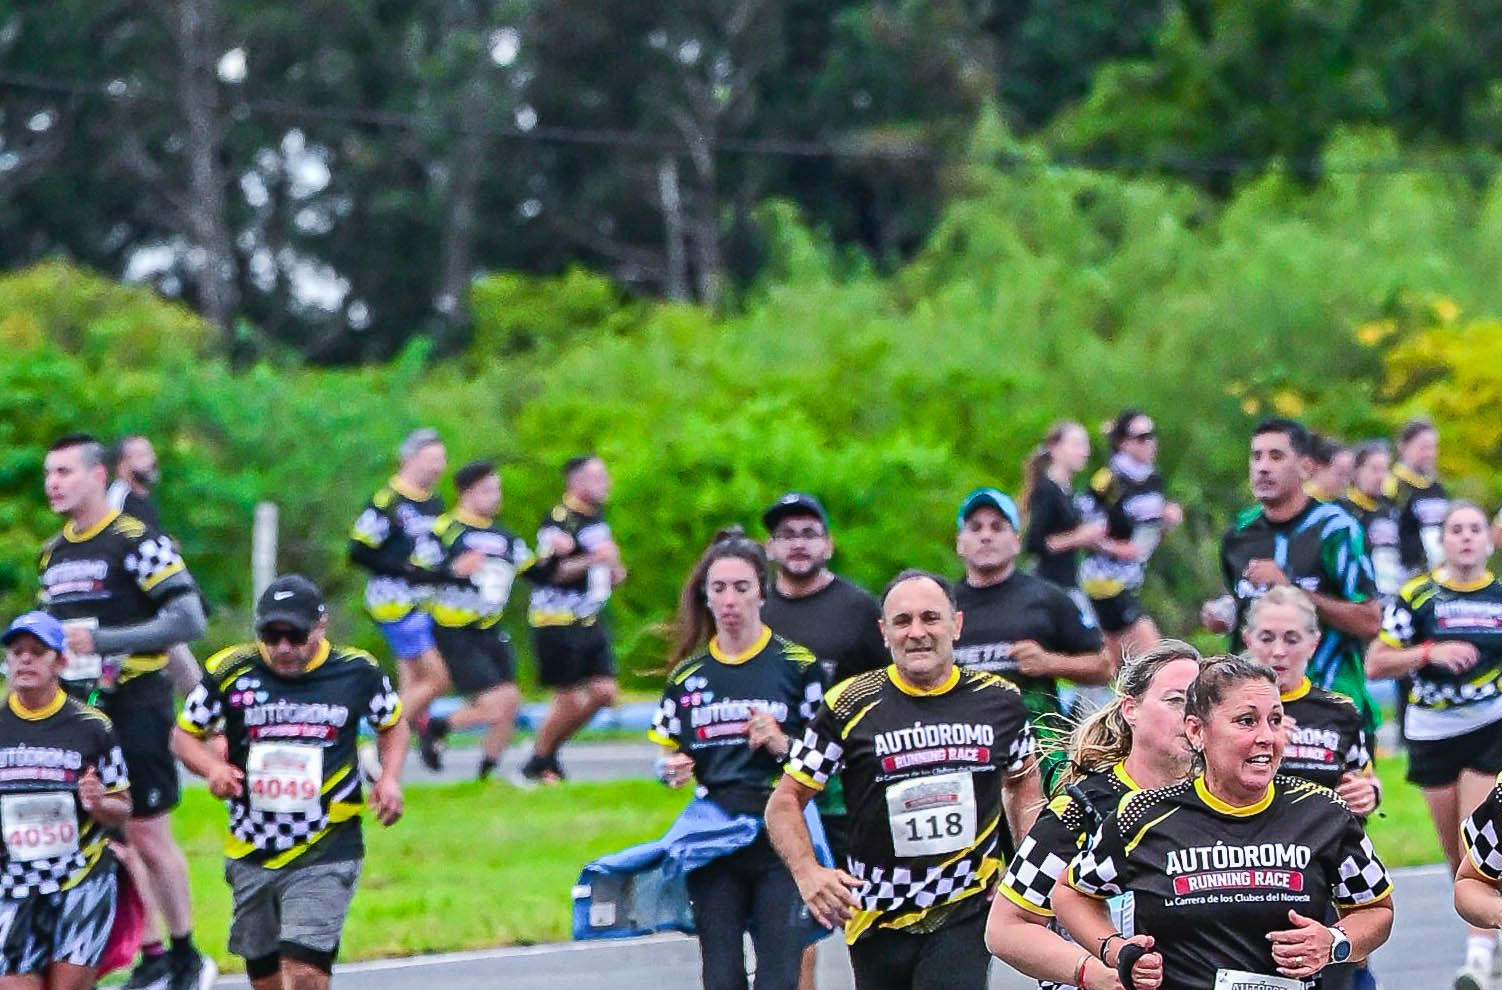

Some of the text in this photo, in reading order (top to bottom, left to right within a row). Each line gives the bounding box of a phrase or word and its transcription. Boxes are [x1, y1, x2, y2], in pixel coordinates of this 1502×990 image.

[875, 721, 995, 757] AUTÓDROMO
[949, 747, 979, 762] RACE
[253, 778, 316, 800] 4049
[9, 821, 74, 847] 4050
[906, 812, 963, 841] 118
[1165, 840, 1311, 876] AUTÓDROMO
[1187, 870, 1291, 891] RUNNING RACE
[1164, 898, 1174, 907] La
[1175, 897, 1206, 906] Carrera
[1207, 894, 1219, 903] de
[1220, 893, 1233, 903] los
[1234, 893, 1264, 903] Clubes
[1266, 893, 1279, 901] del
